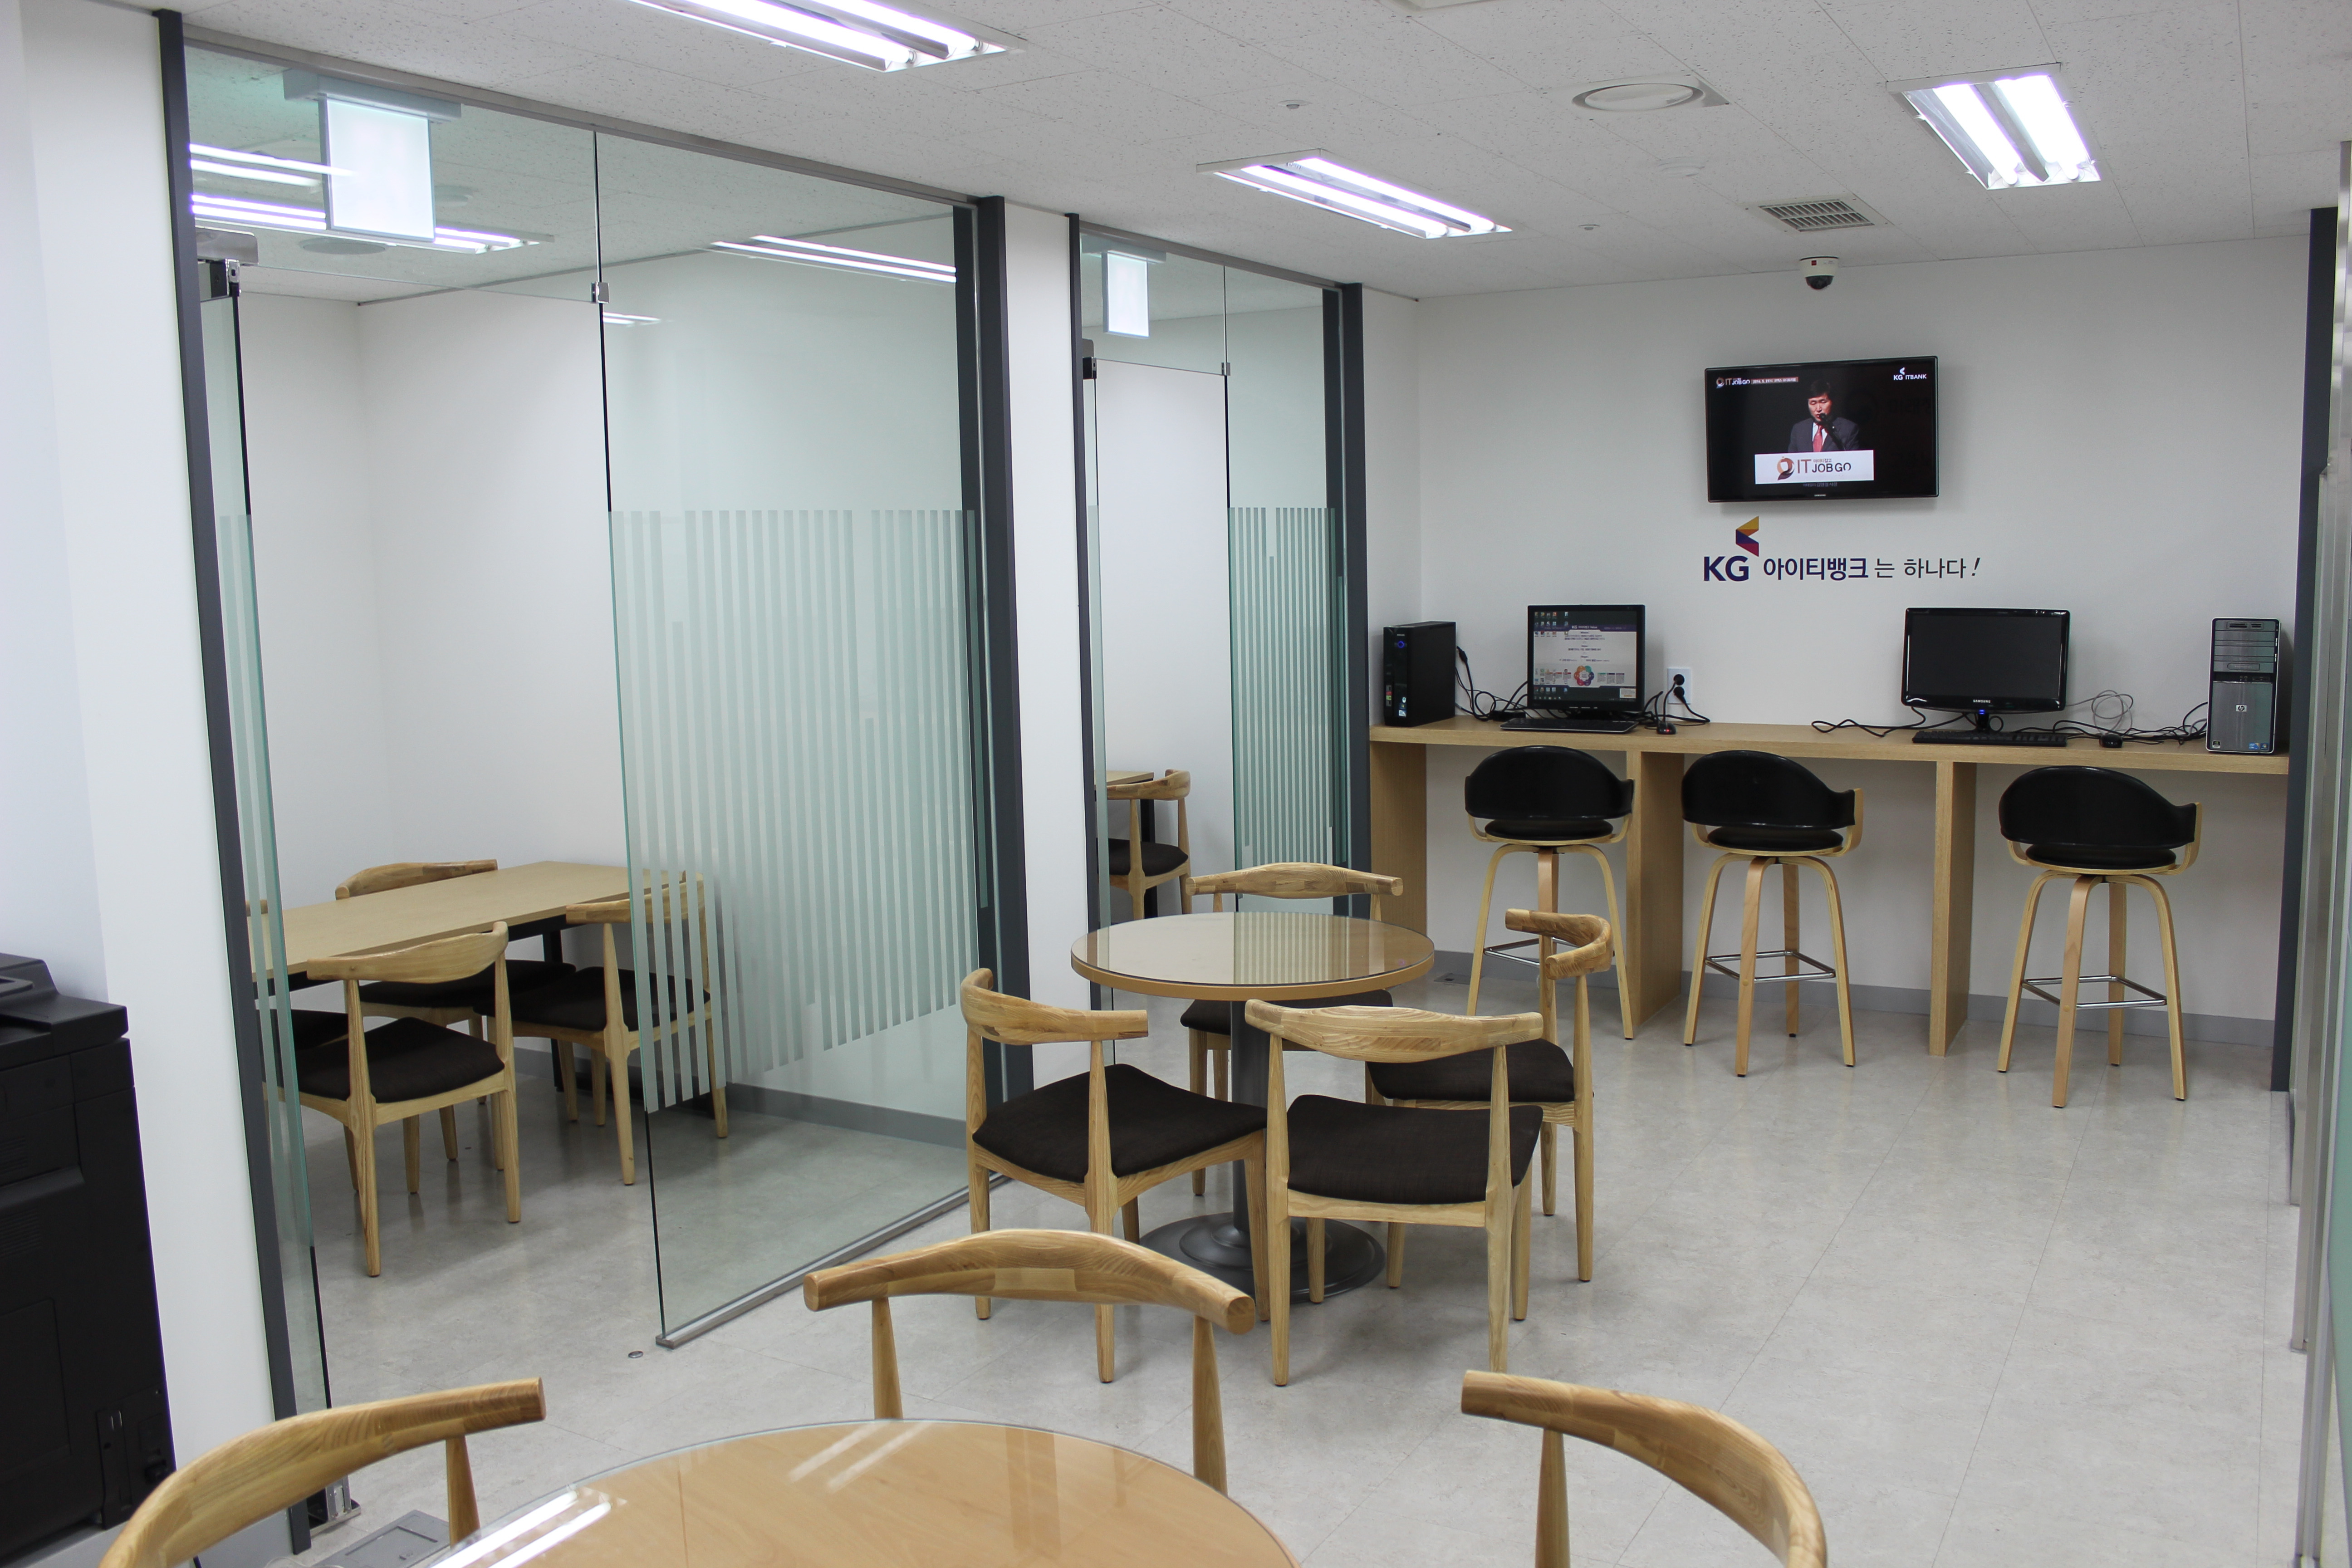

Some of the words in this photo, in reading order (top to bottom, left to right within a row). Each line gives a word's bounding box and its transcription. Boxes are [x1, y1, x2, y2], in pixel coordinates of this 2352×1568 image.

[1797, 459, 1812, 473] IT
[1812, 463, 1833, 473] JOB
[1834, 462, 1852, 472] GO
[1703, 555, 1749, 581] KG
